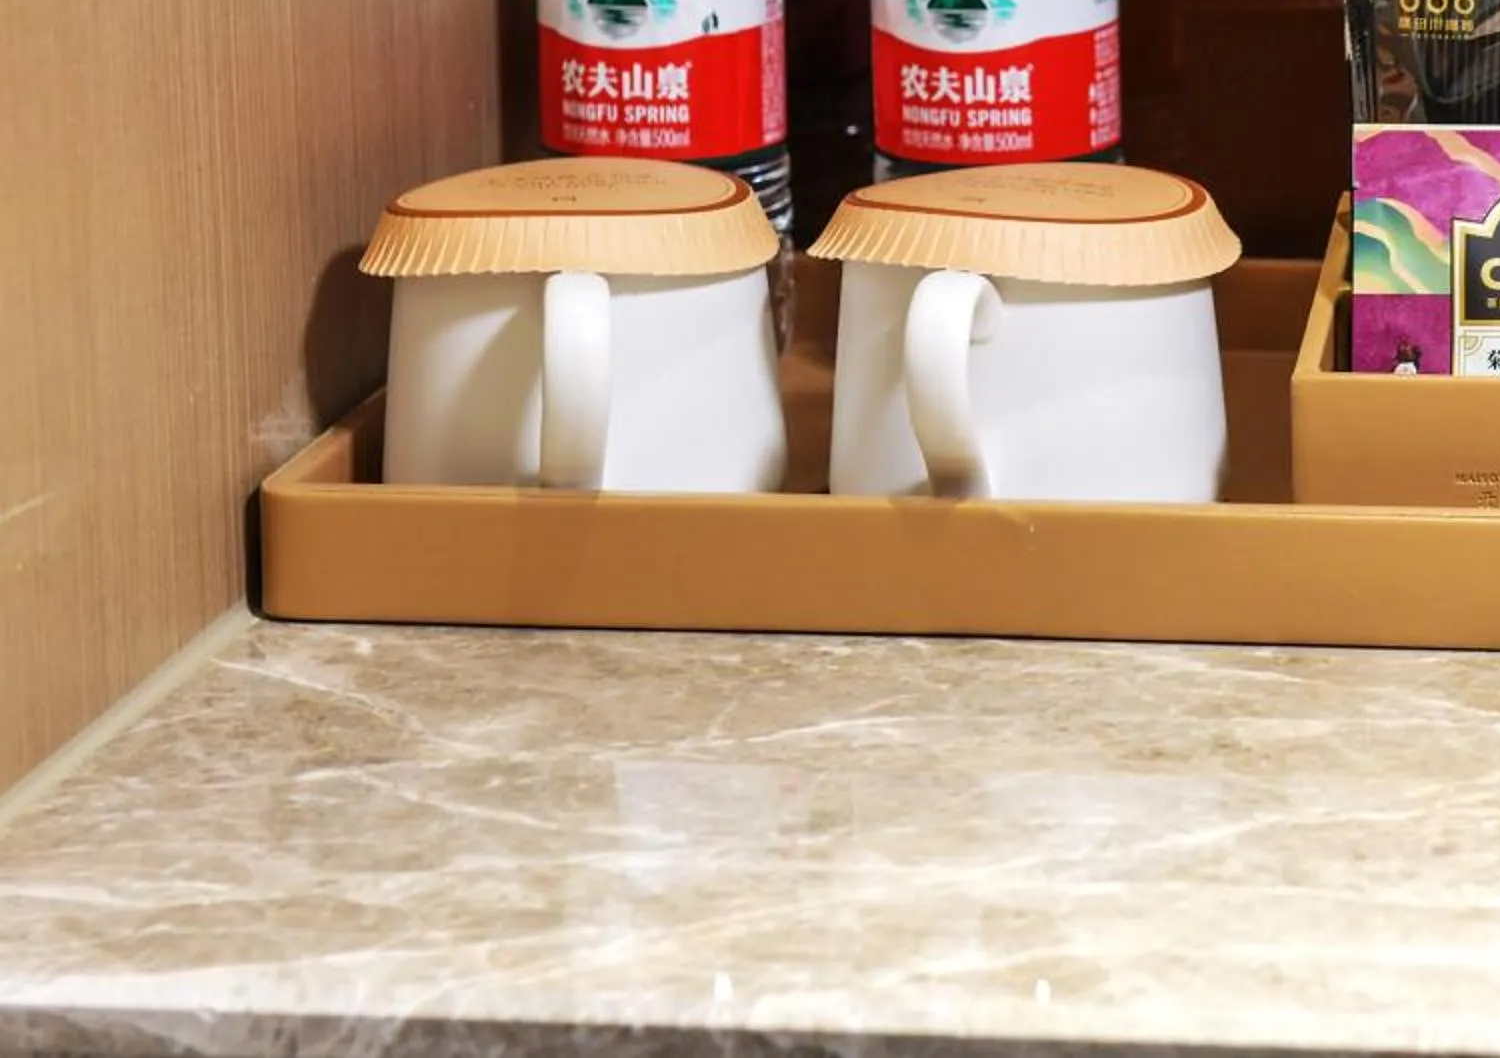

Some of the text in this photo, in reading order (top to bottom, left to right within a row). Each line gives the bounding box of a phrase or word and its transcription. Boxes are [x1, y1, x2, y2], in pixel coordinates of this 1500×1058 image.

[562, 59, 689, 101] 农夫山泉
[901, 63, 1032, 104] 农夫山泉
[624, 104, 690, 124] SPRING
[966, 107, 1033, 127] SPRING
